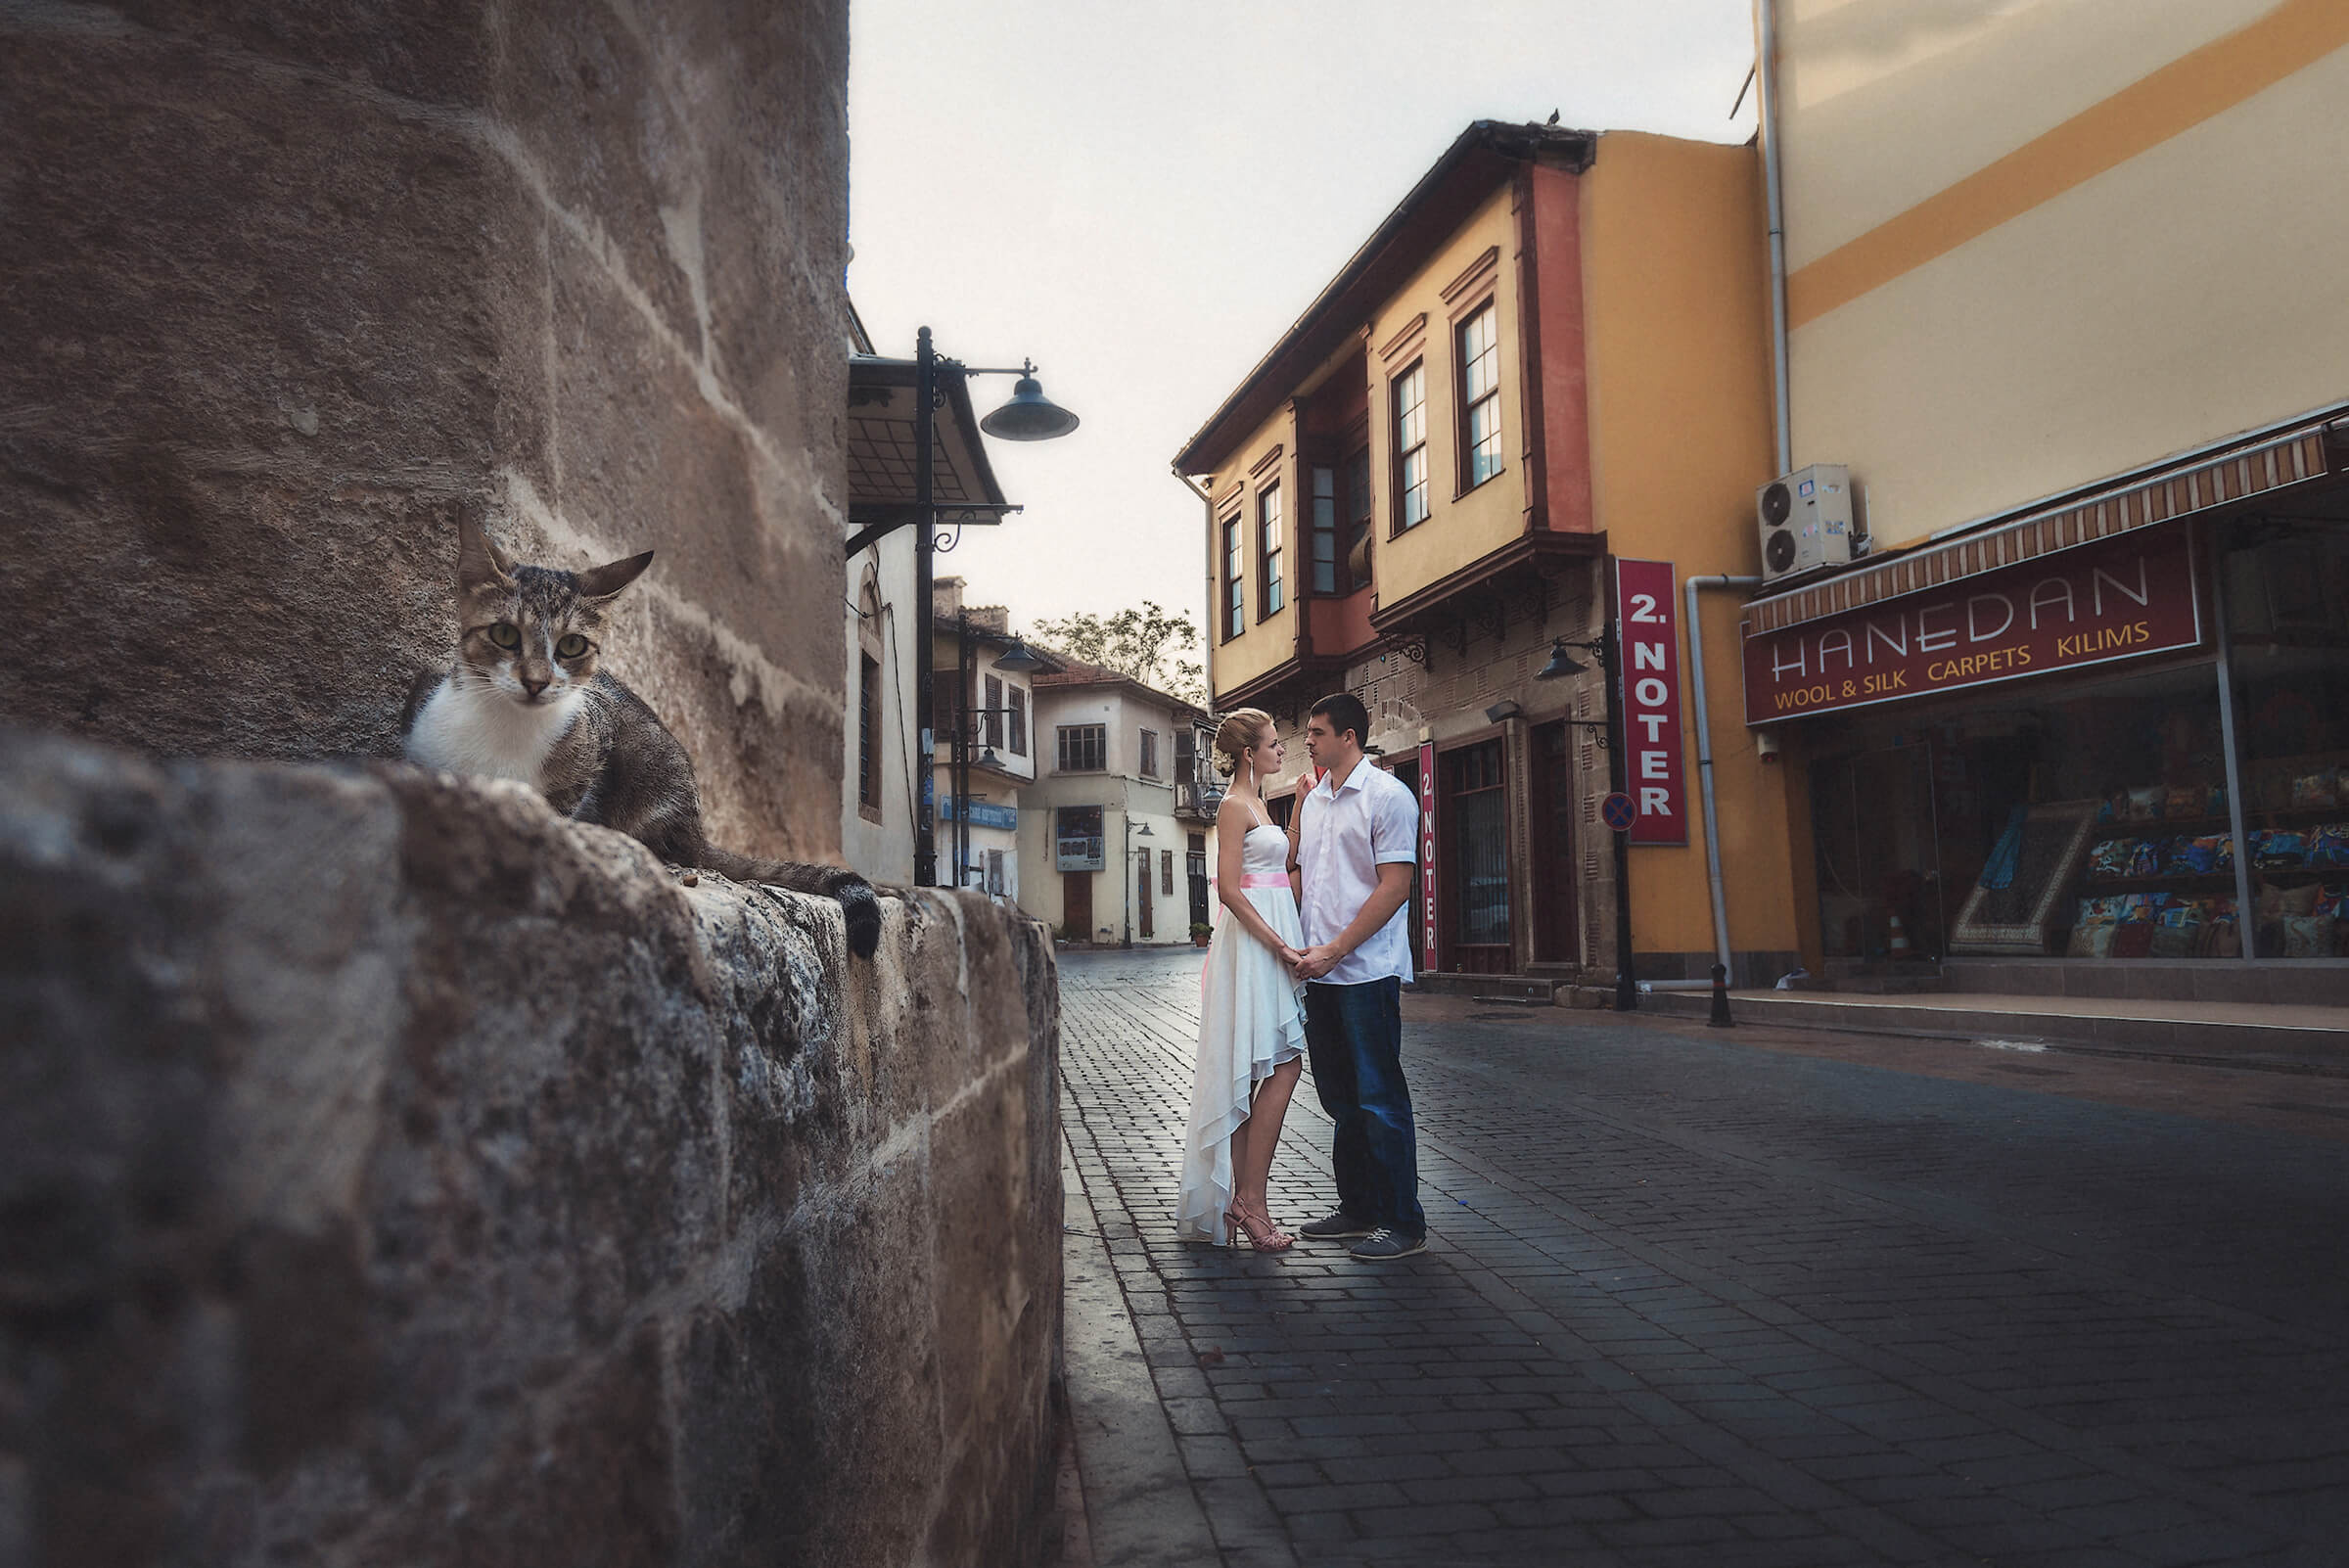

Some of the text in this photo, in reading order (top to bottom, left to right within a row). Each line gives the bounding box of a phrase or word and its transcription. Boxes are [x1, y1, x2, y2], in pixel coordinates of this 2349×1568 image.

[1772, 555, 2149, 682] HANEDAN
[1773, 621, 2151, 711] WOOL & SILK CARPETS KILIMS
[1630, 593, 1673, 816] 2. NOTER
[1424, 810, 1435, 949] NOTER
